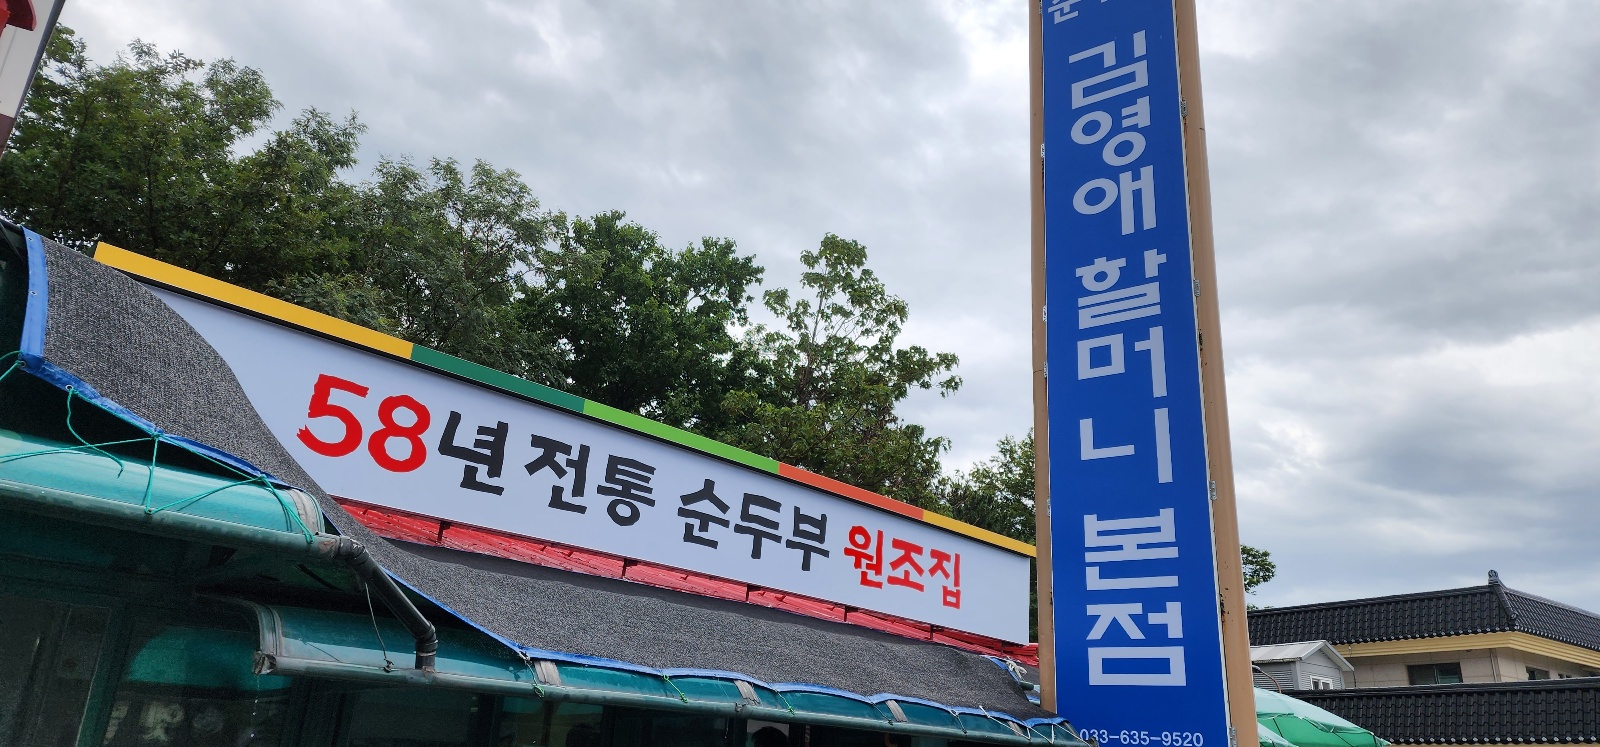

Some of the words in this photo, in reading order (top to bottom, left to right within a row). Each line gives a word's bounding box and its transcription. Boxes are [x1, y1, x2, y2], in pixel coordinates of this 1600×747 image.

[1069, 29, 1156, 235] 김영애
[1076, 249, 1173, 483] 할머니
[296, 373, 509, 496] 58년
[524, 433, 657, 527] 전통
[677, 478, 830, 571] 순두부
[844, 525, 961, 609] 원조집
[1083, 507, 1187, 687] 본점
